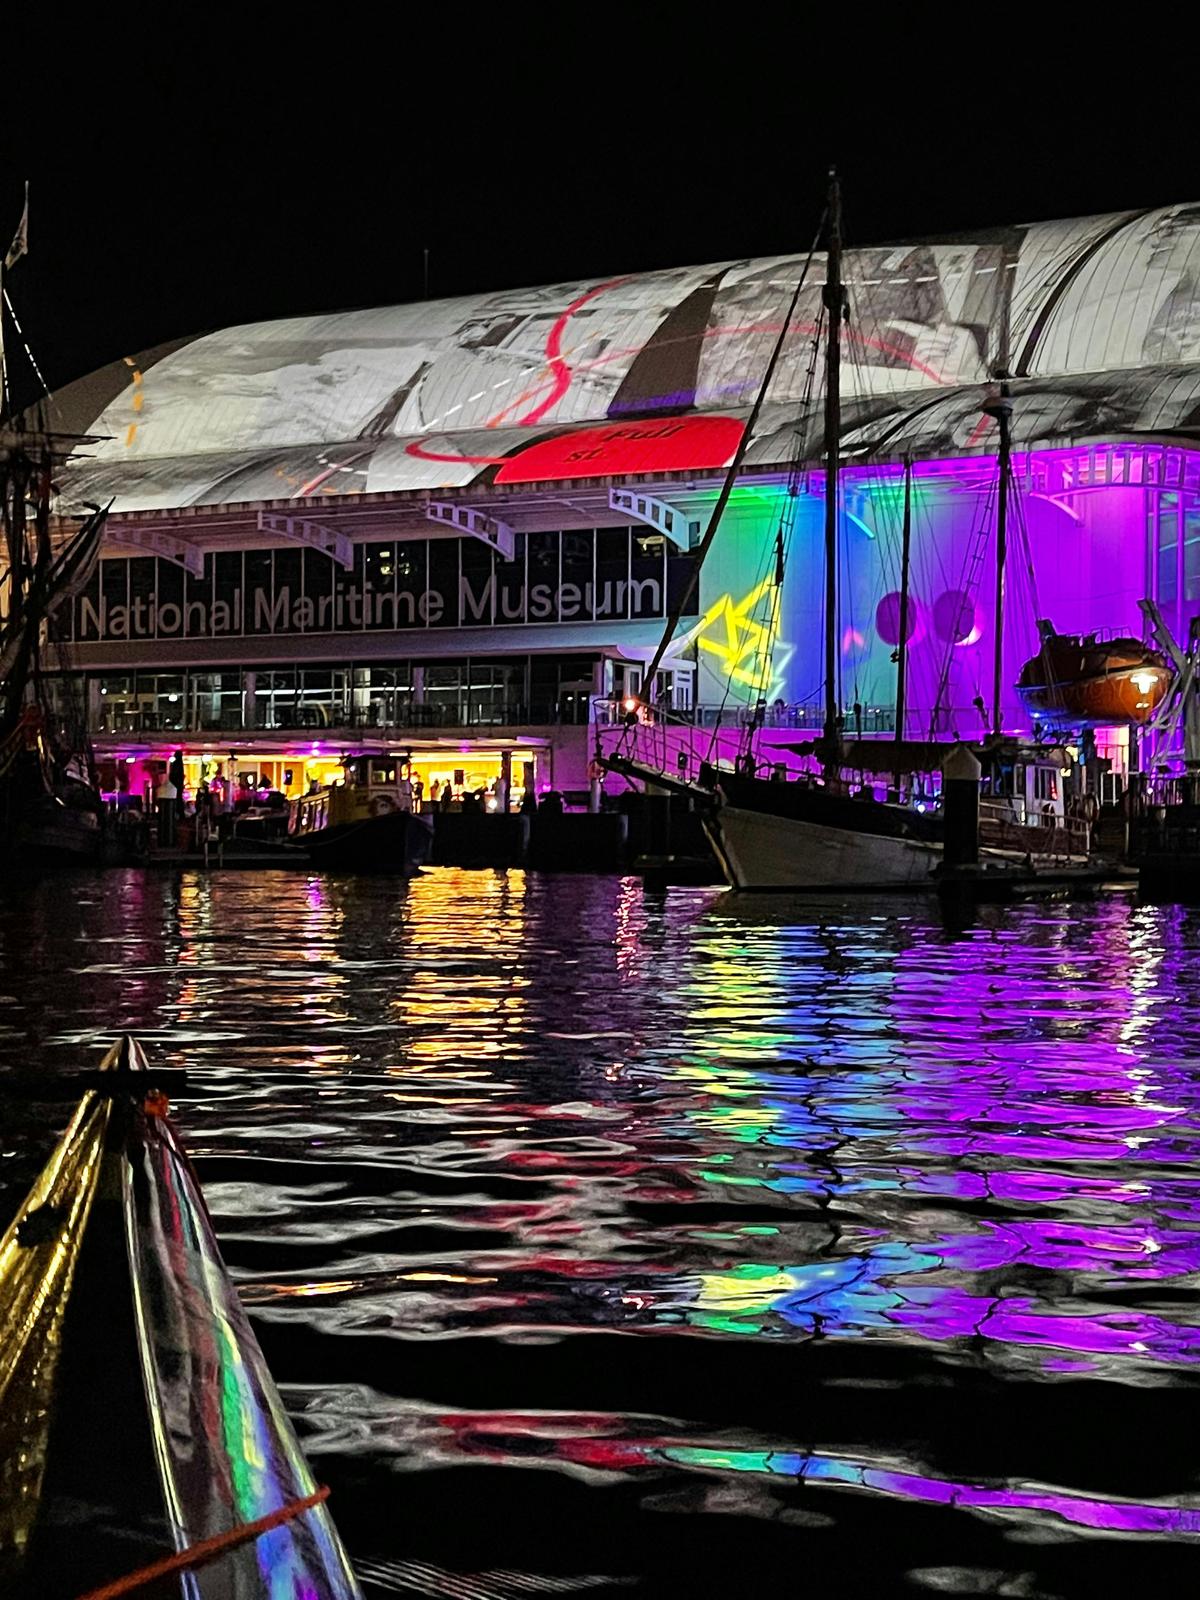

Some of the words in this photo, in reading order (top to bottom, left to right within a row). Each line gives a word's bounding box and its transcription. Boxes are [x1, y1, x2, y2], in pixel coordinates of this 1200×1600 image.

[80, 588, 240, 637] National
[254, 581, 444, 630] Maritime
[460, 574, 661, 621] Museum
